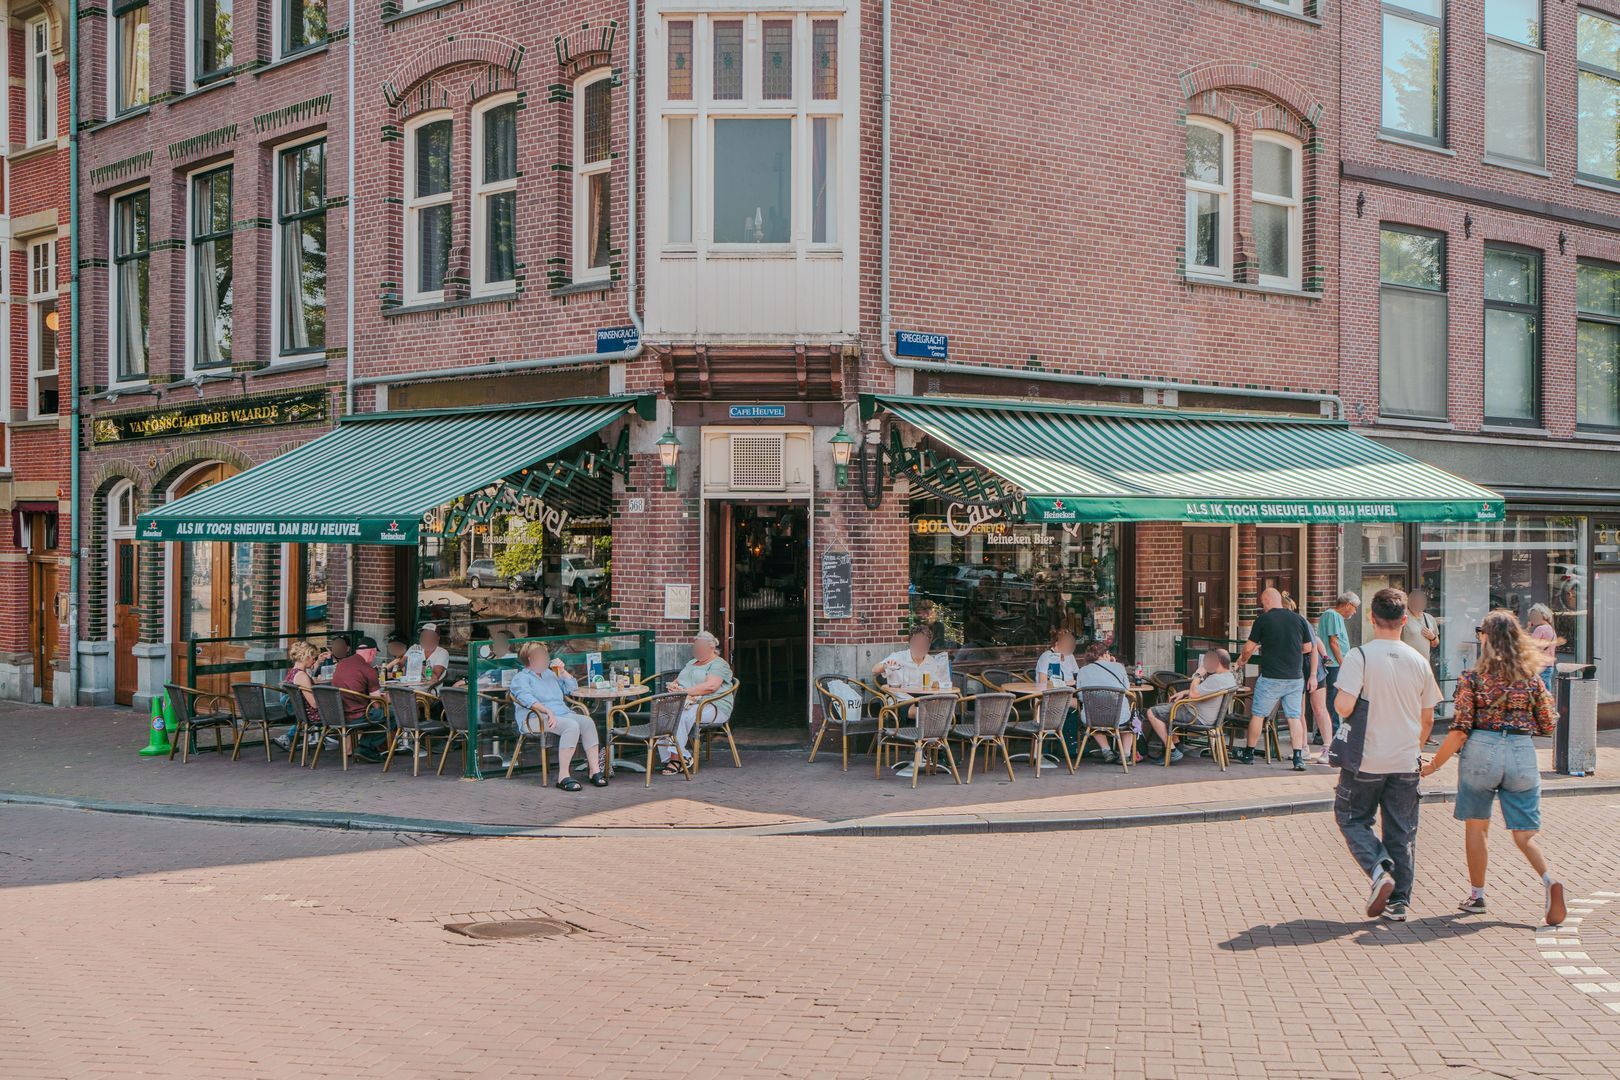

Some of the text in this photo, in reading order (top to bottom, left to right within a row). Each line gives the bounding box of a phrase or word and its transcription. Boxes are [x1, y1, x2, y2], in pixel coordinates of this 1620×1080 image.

[901, 333, 945, 345] SPIEGELGRACHT
[752, 407, 784, 416] HEUVEL
[129, 405, 279, 433] VAN ONSCHATBARE WAARDE
[629, 499, 643, 512] 568
[1186, 503, 1398, 517] ALS IK TOCH SNEUVEL DAN BIJ HEUVEL
[1043, 510, 1076, 519] Heineken
[177, 522, 362, 537] ALS IK TOCH SNEUVEL DAN BIJ HEUVEL
[917, 519, 956, 533] BOL
[380, 531, 406, 541] Heineken
[987, 533, 1055, 545] Heineken Bier
